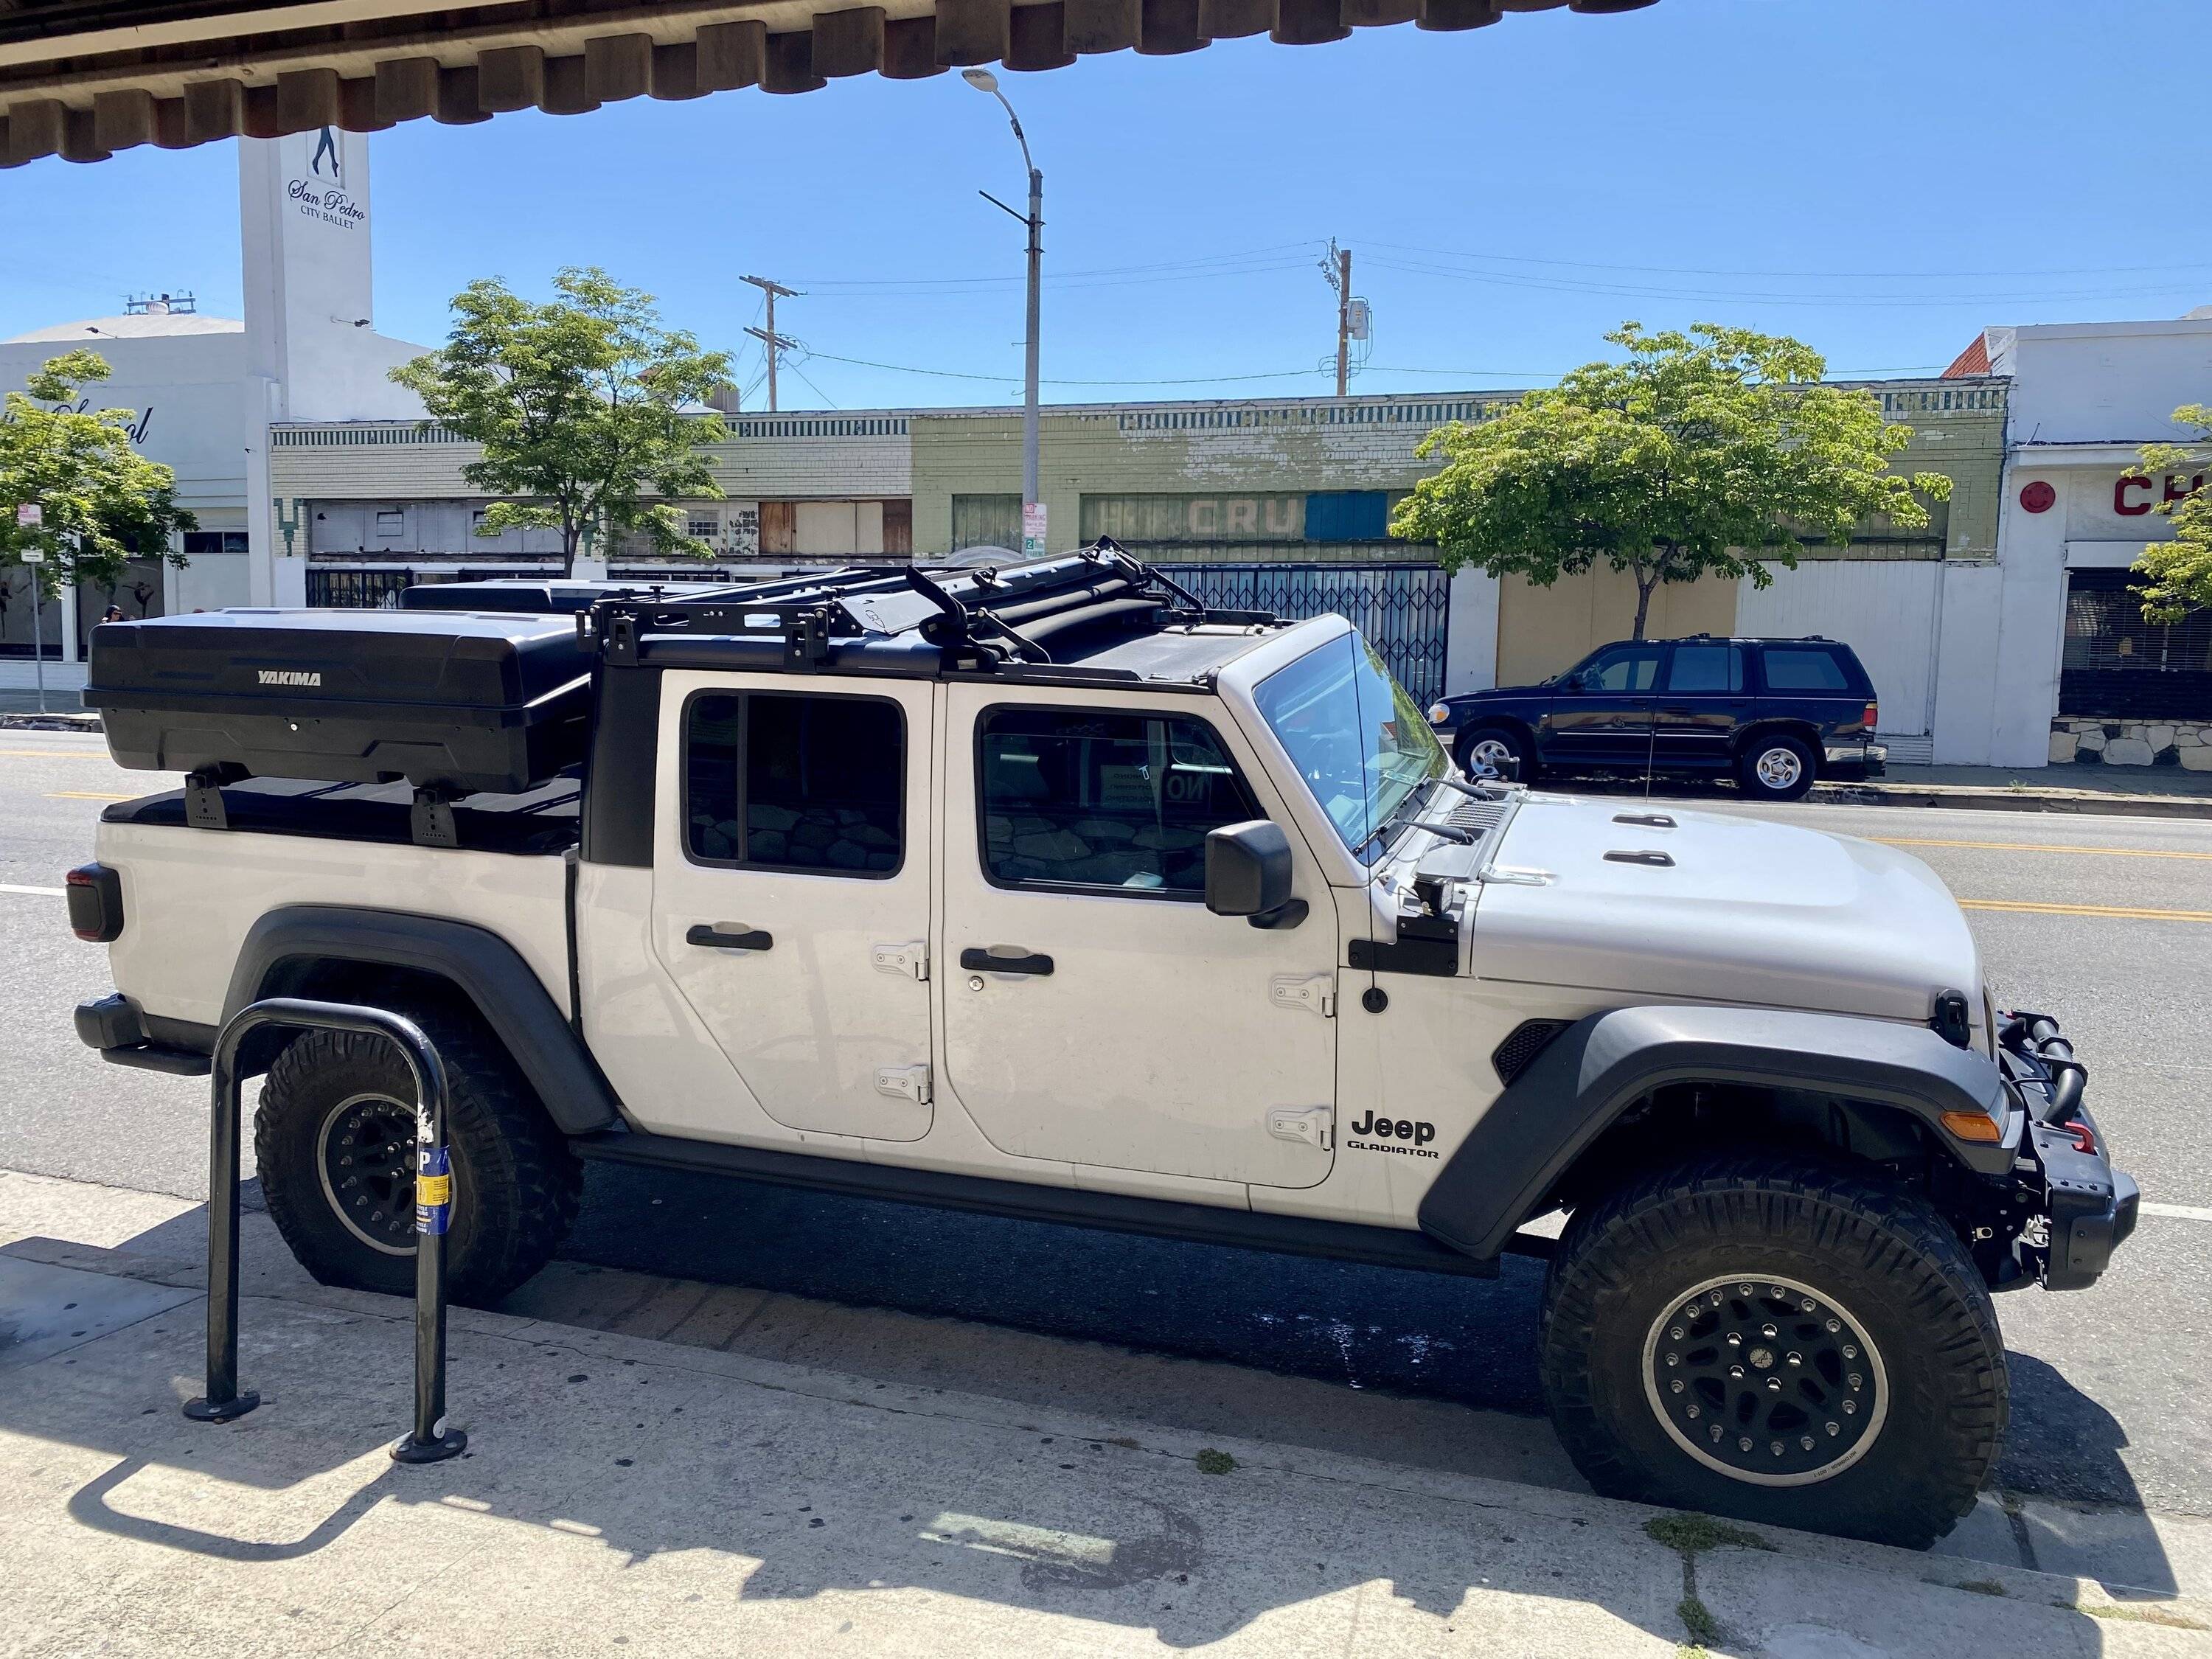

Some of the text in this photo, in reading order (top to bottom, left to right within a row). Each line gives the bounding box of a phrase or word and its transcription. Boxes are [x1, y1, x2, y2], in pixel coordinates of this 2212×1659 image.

[288, 179, 366, 220] San Pedro
[300, 205, 355, 230] CITY BALLET
[258, 670, 321, 686] YAKIMA
[1352, 1110, 1436, 1146] Jeep
[1347, 1141, 1439, 1159] GLADIATOR
